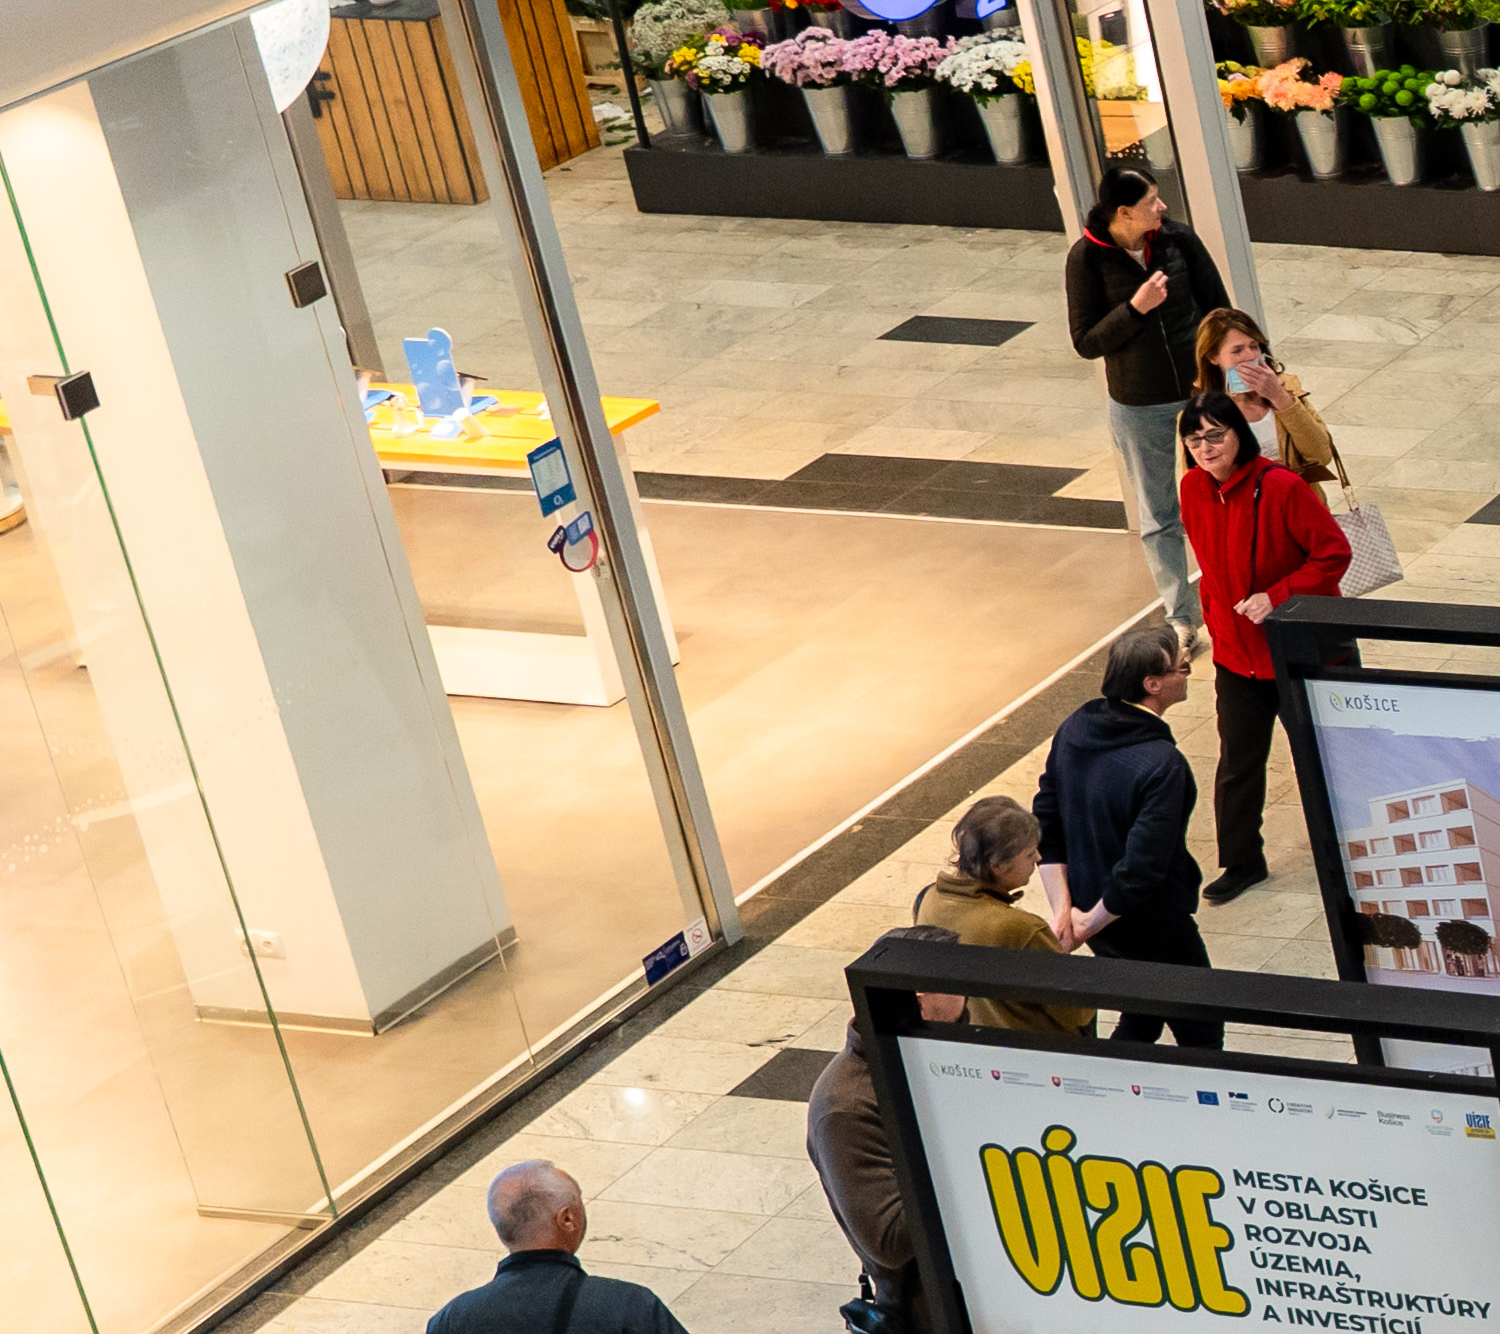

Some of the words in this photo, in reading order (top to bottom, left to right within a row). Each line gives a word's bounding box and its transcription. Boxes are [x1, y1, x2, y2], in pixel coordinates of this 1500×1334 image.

[1344, 693, 1399, 714] KOŠICE
[941, 1064, 982, 1079] KOŠICE
[1232, 1168, 1322, 1197] MESTA
[1329, 1173, 1429, 1207] KOŠICE
[979, 1124, 1250, 1318] VÍZIE
[1238, 1197, 1257, 1216] V
[1264, 1200, 1378, 1228] OBLASTI
[1245, 1224, 1372, 1254] ROZVOJA
[1250, 1247, 1362, 1282] ÚZEMIA,
[1256, 1277, 1492, 1321] INFRAŠTRUKTÚRY
[1263, 1305, 1282, 1323] A
